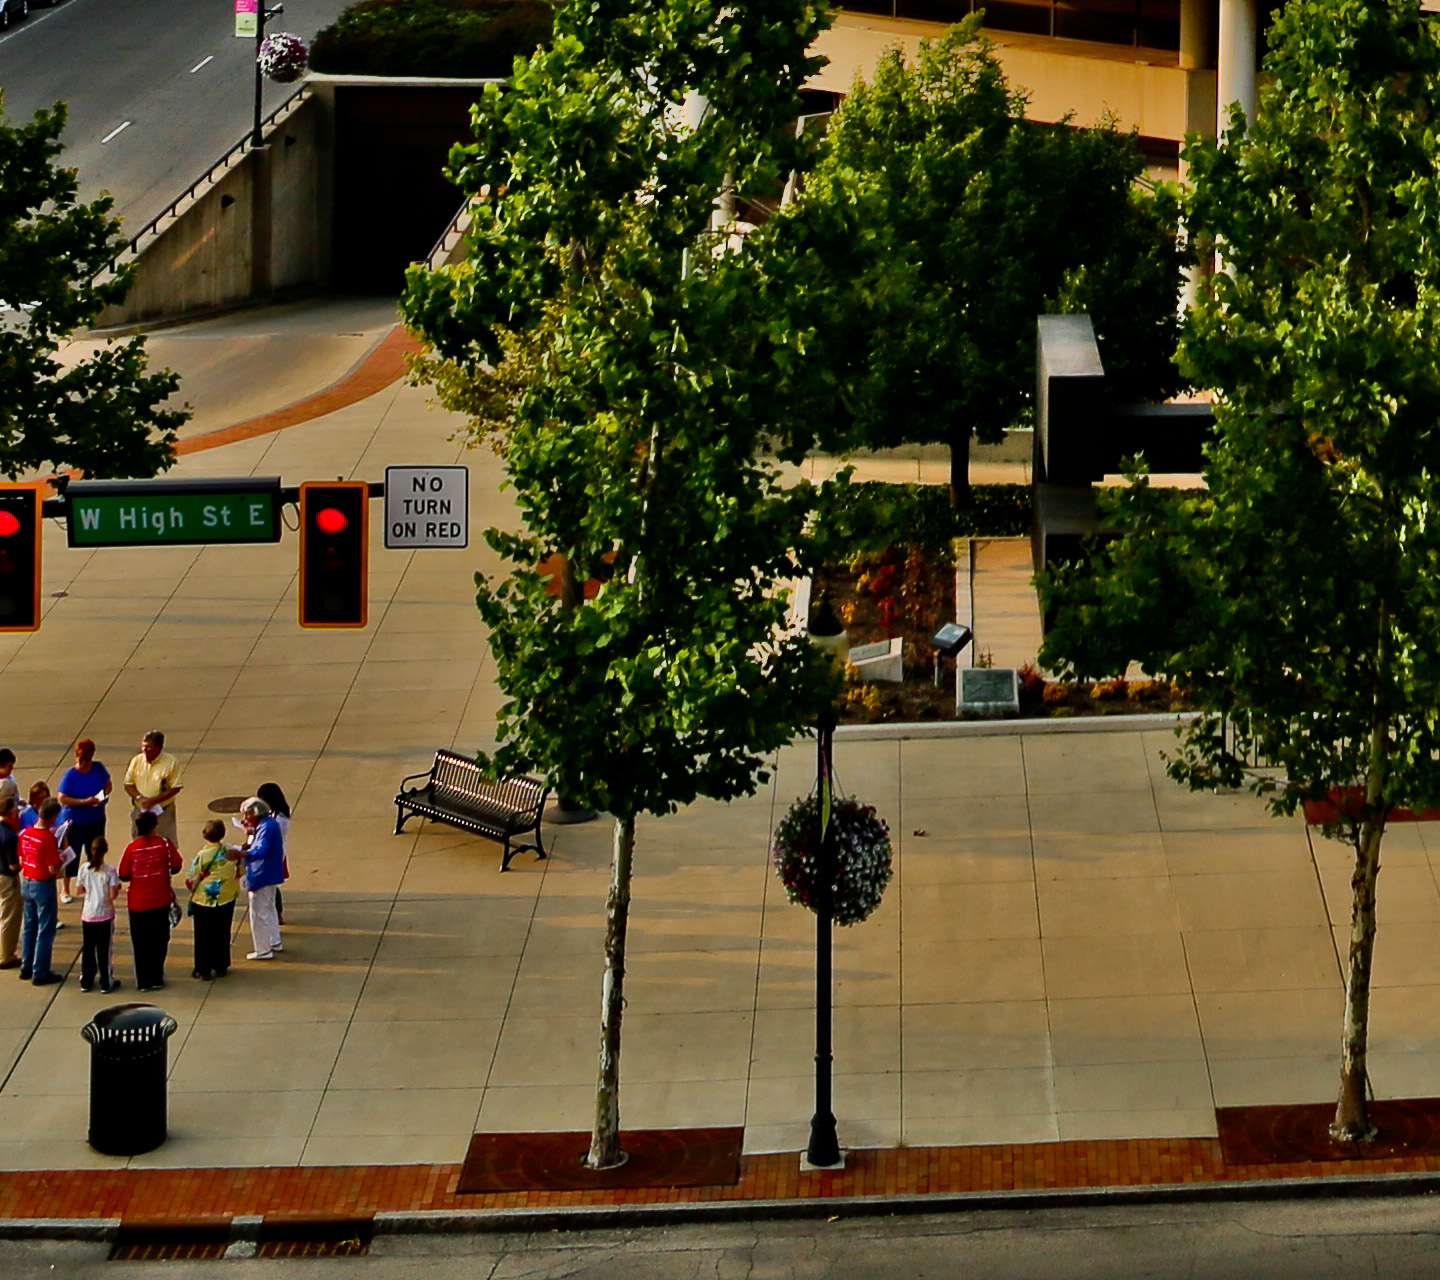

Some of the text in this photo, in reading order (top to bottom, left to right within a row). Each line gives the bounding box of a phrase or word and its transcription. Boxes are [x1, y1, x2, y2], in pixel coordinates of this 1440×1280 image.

[412, 476, 443, 493] NO
[402, 499, 451, 515] TURN
[79, 504, 265, 536] W High St E
[392, 521, 461, 538] ON RED
